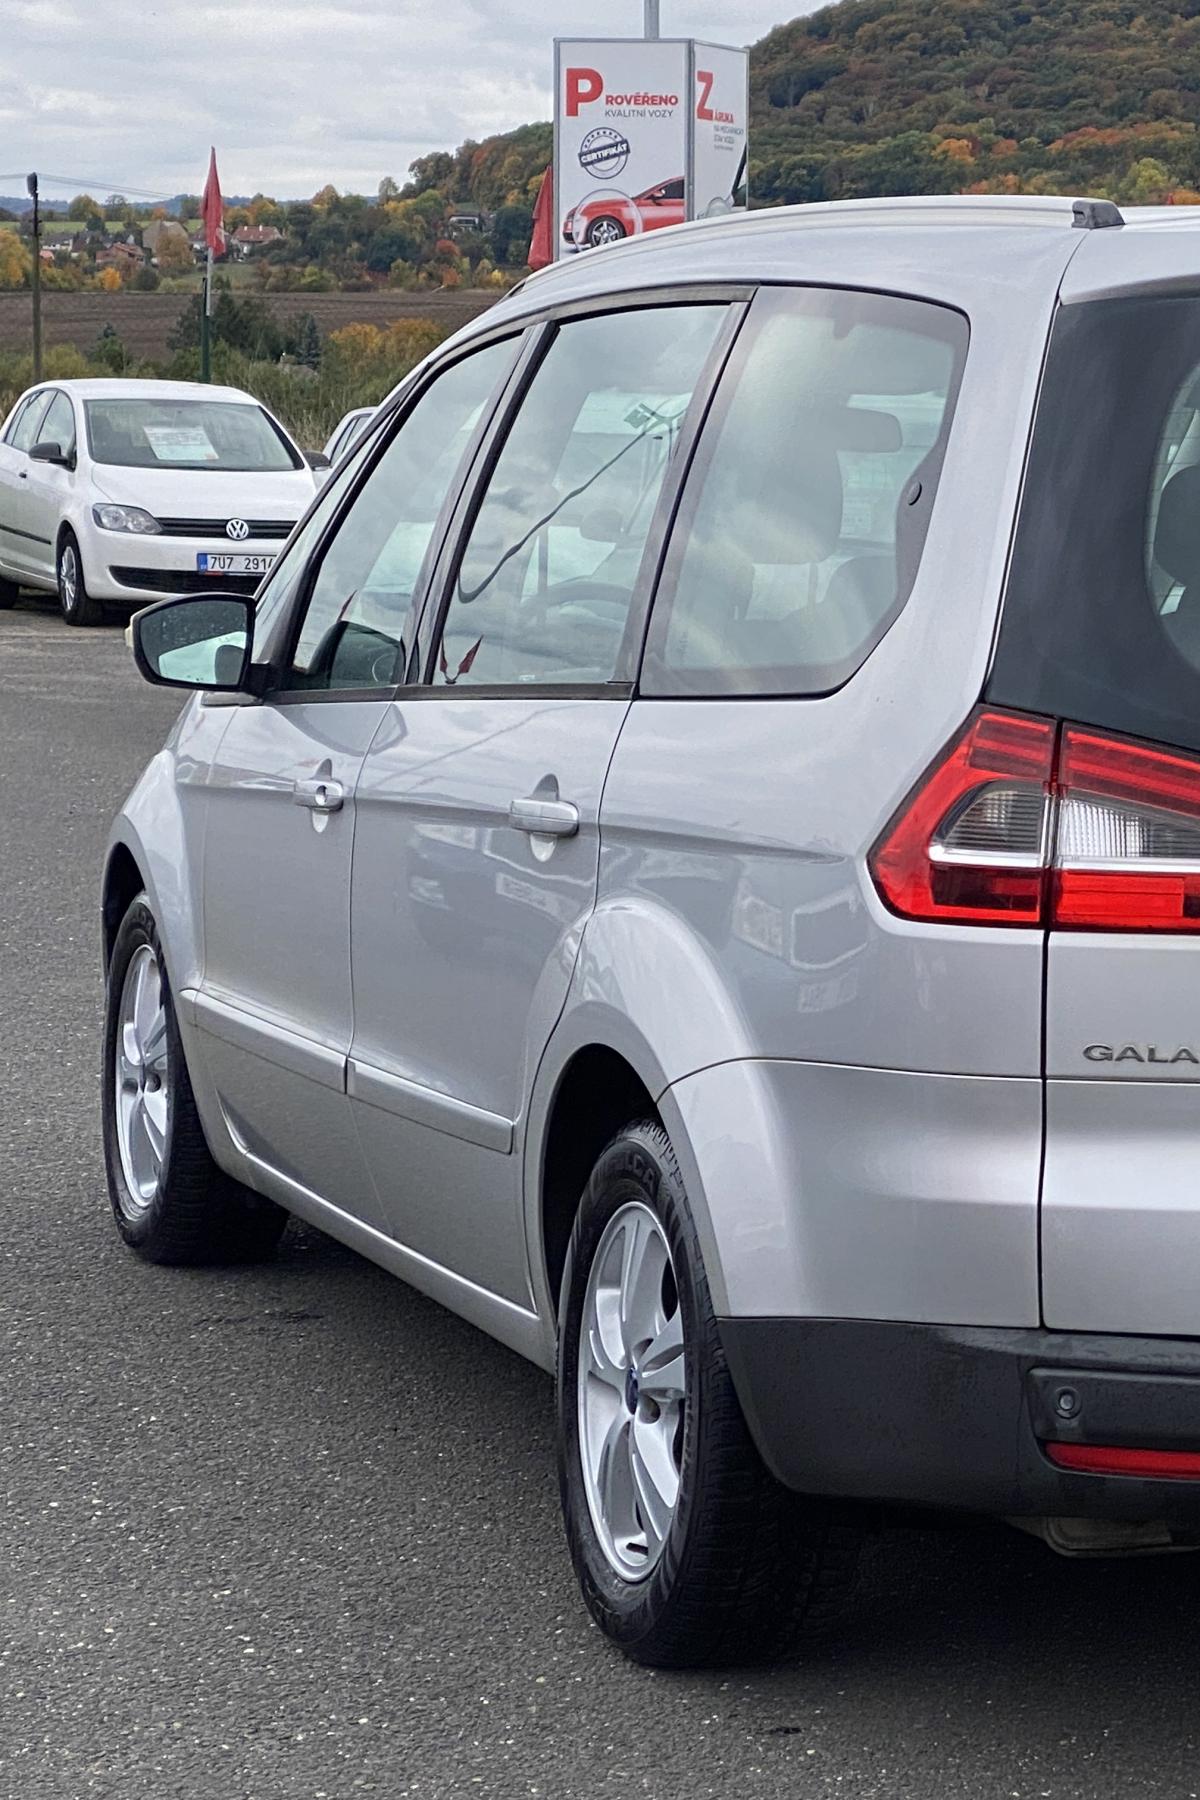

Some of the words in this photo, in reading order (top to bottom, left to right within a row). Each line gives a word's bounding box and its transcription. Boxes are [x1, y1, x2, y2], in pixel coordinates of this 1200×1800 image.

[604, 108, 646, 118] KVALITNÍ
[648, 109, 674, 118] VOZY
[581, 142, 628, 164] CERTIFIKÁT
[210, 556, 234, 570] 7U7
